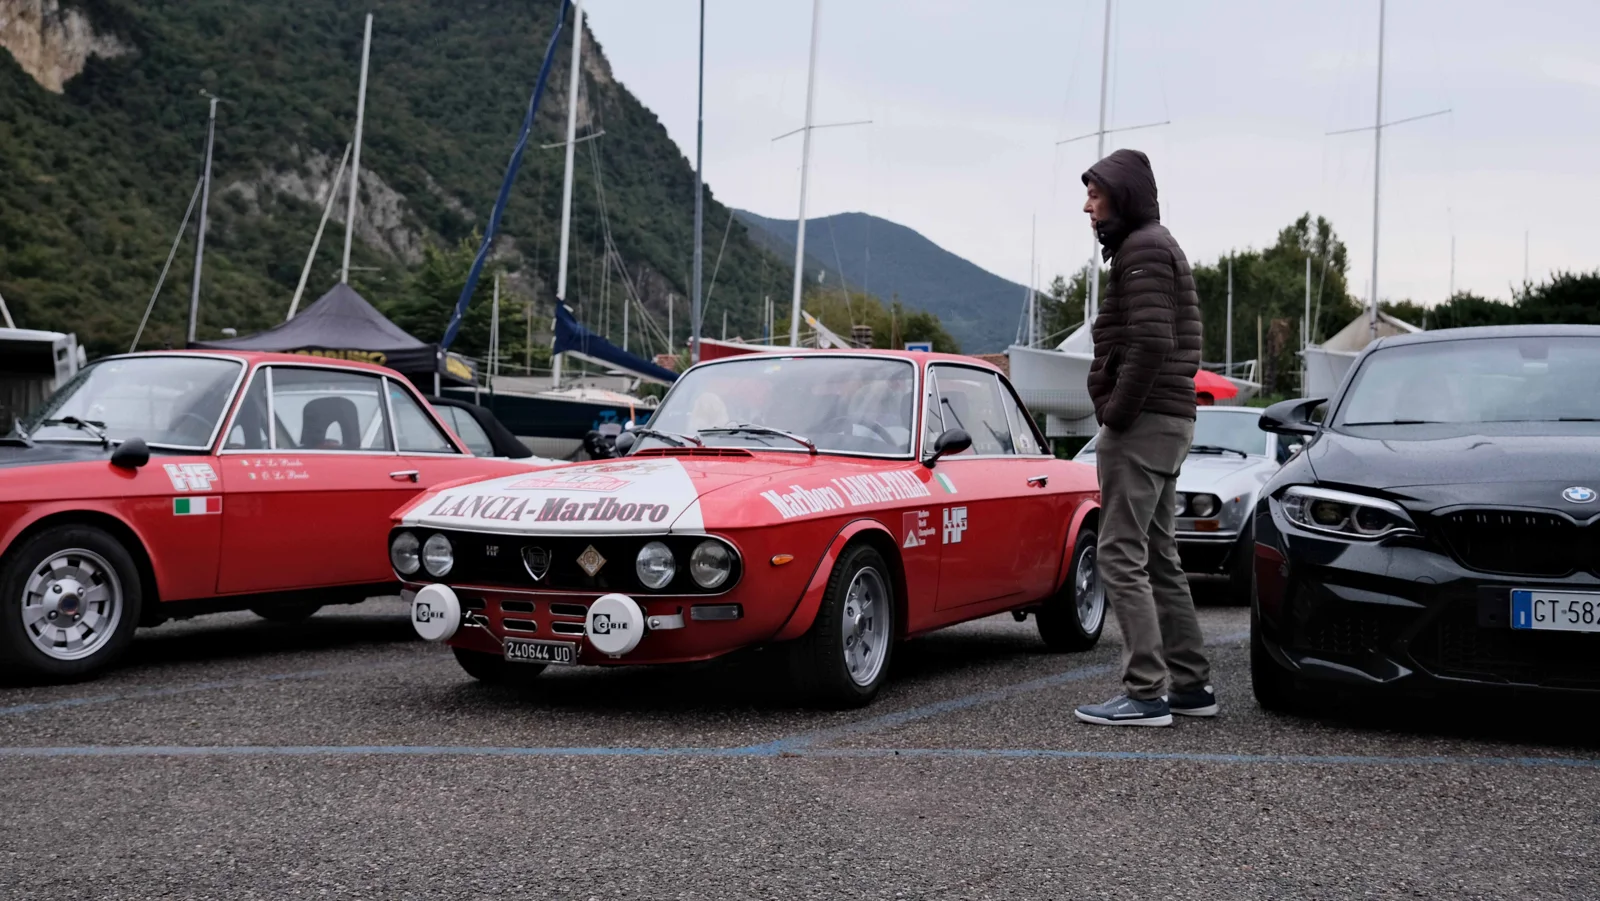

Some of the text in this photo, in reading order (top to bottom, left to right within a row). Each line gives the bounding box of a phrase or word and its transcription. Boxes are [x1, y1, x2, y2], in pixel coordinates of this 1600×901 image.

[162, 463, 218, 491] HF
[760, 470, 931, 519] Marlboro LANCIA-ITALIA
[942, 506, 968, 545] HF
[507, 642, 570, 662] 240644 UD
